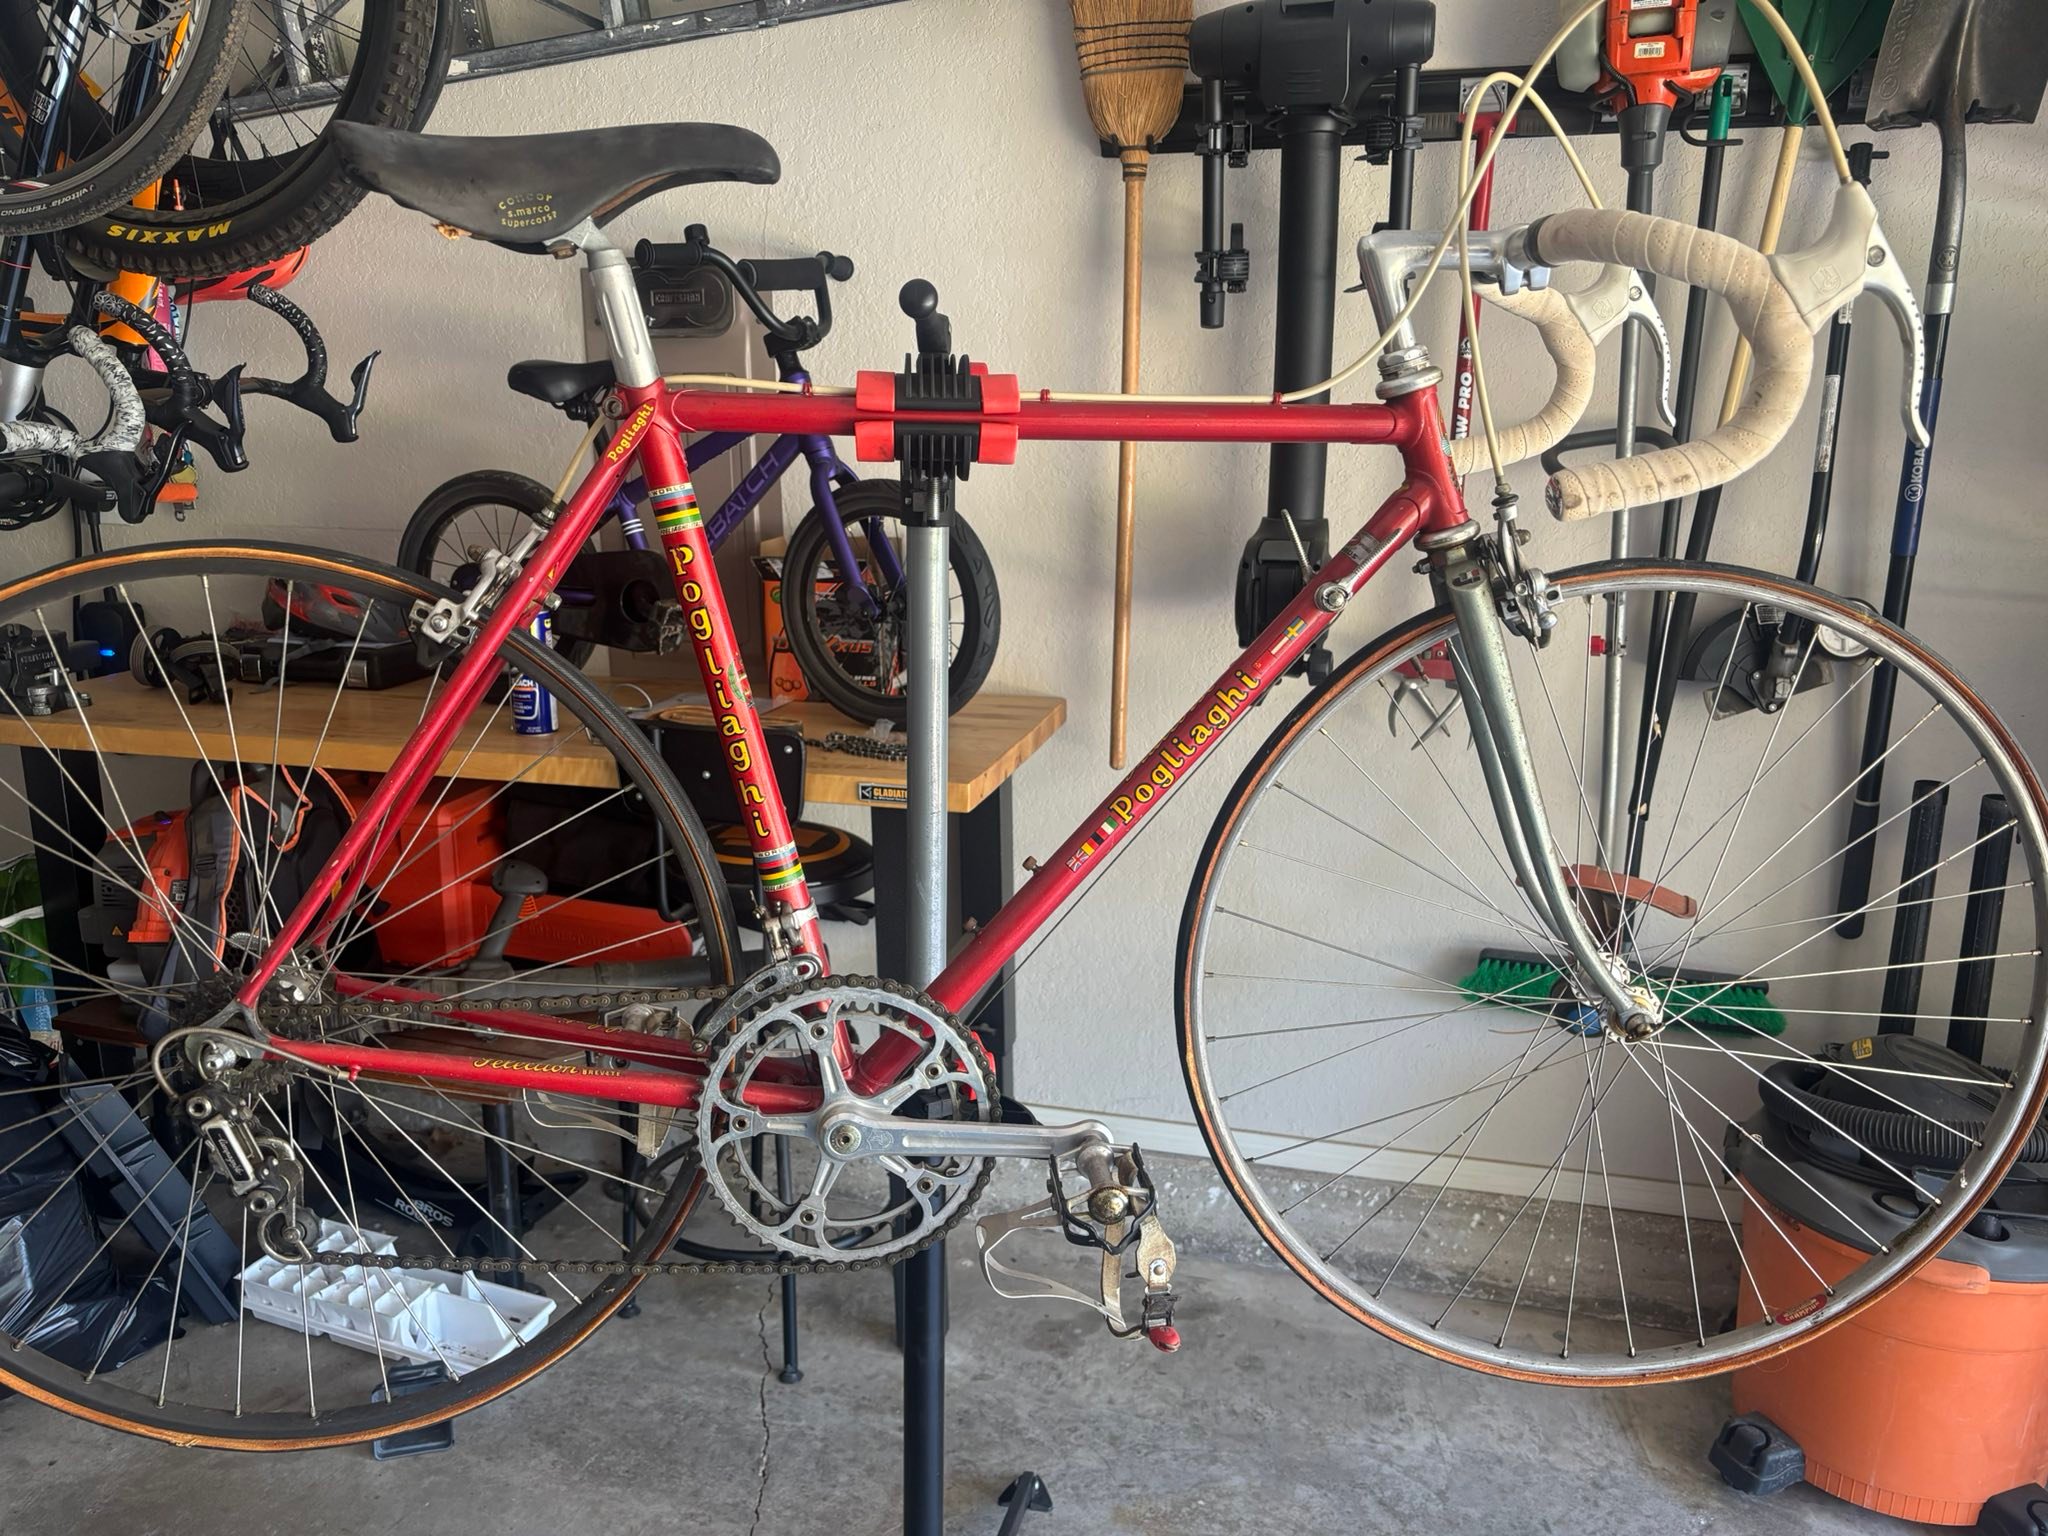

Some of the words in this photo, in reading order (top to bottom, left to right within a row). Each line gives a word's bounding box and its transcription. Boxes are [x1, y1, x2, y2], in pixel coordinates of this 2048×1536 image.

[1, 203, 47, 217] TERRENO
[106, 220, 232, 244] MAXXIS
[1458, 371, 1472, 409] PRO
[606, 403, 655, 462] Pogliaghi
[1911, 446, 1926, 483] KOBA
[651, 484, 687, 496] WORLD
[669, 543, 771, 838] Pogliaghi
[1109, 669, 1261, 825] Pogliaghi
[414, 1199, 454, 1227] BROS
